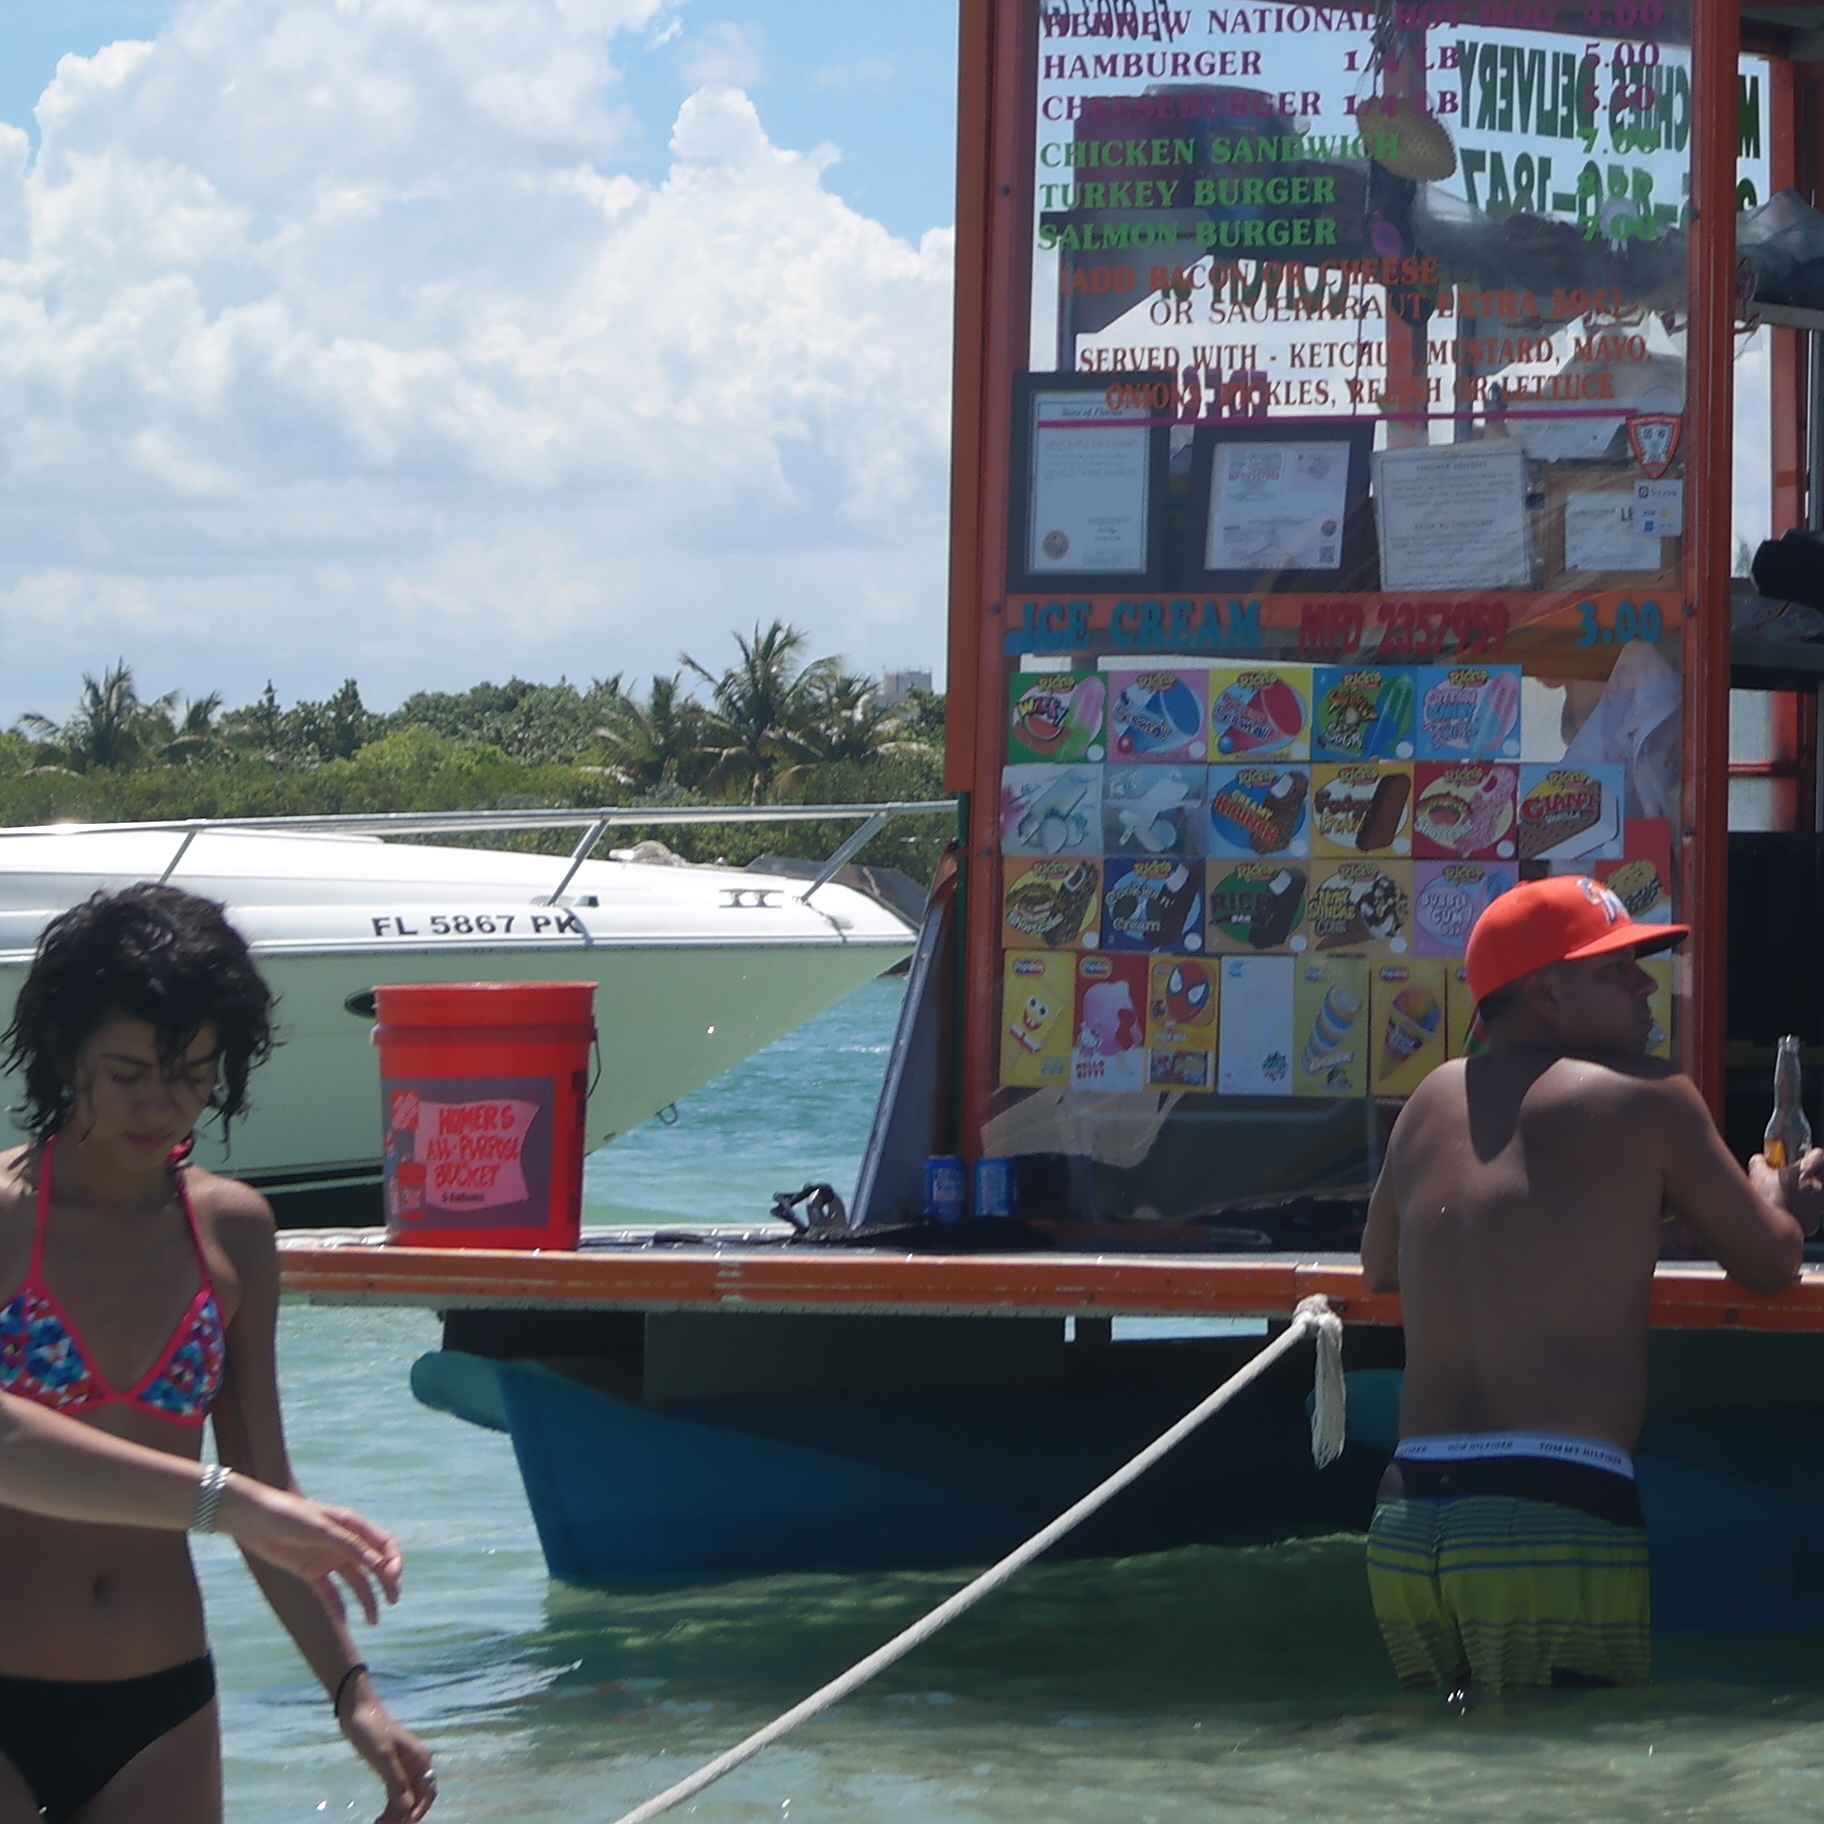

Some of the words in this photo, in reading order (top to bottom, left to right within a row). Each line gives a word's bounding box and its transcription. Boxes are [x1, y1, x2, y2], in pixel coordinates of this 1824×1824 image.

[1206, 4, 1379, 35] NATIONAL
[1394, 2, 1465, 30] HOT
[1480, 1, 1558, 27] DOG
[1043, 50, 1263, 80] HAMBURGER
[1343, 45, 1399, 73] 1/4
[1416, 45, 1461, 72] LB
[1584, 41, 1660, 69] 5.00
[1041, 90, 1321, 122] CHEESEBURGER
[1343, 92, 1397, 117] 1/4
[1416, 91, 1460, 116] LB
[1039, 136, 1195, 169] CHICKEN
[1210, 132, 1401, 165] SANDWICH
[1038, 179, 1180, 211] TURKEY
[1192, 177, 1337, 208] BURGER
[1036, 221, 1180, 253] SALMON
[1201, 217, 1337, 249] BURGER
[1061, 264, 1137, 298] (ADD
[1150, 259, 1254, 292] BACON
[1312, 256, 1439, 287] CHEESE
[1150, 298, 1194, 326] OR
[1208, 293, 1428, 325] SAUERKRAUT
[1437, 290, 1539, 320] EXTRA
[1078, 343, 1180, 375] SERVED
[1191, 341, 1257, 370] WITH
[1501, 373, 1615, 401] LETTUCE
[1021, 602, 1092, 649] ICE
[1109, 599, 1261, 648] CREAM
[1575, 600, 1661, 644] 3.00
[1521, 792, 1600, 821] GIANT
[1211, 891, 1277, 913] RICH
[371, 915, 418, 937] FL
[429, 914, 516, 935] 5867
[530, 915, 584, 934] PK
[1112, 916, 1163, 932] Cream
[434, 1160, 501, 1190] BUCKET
